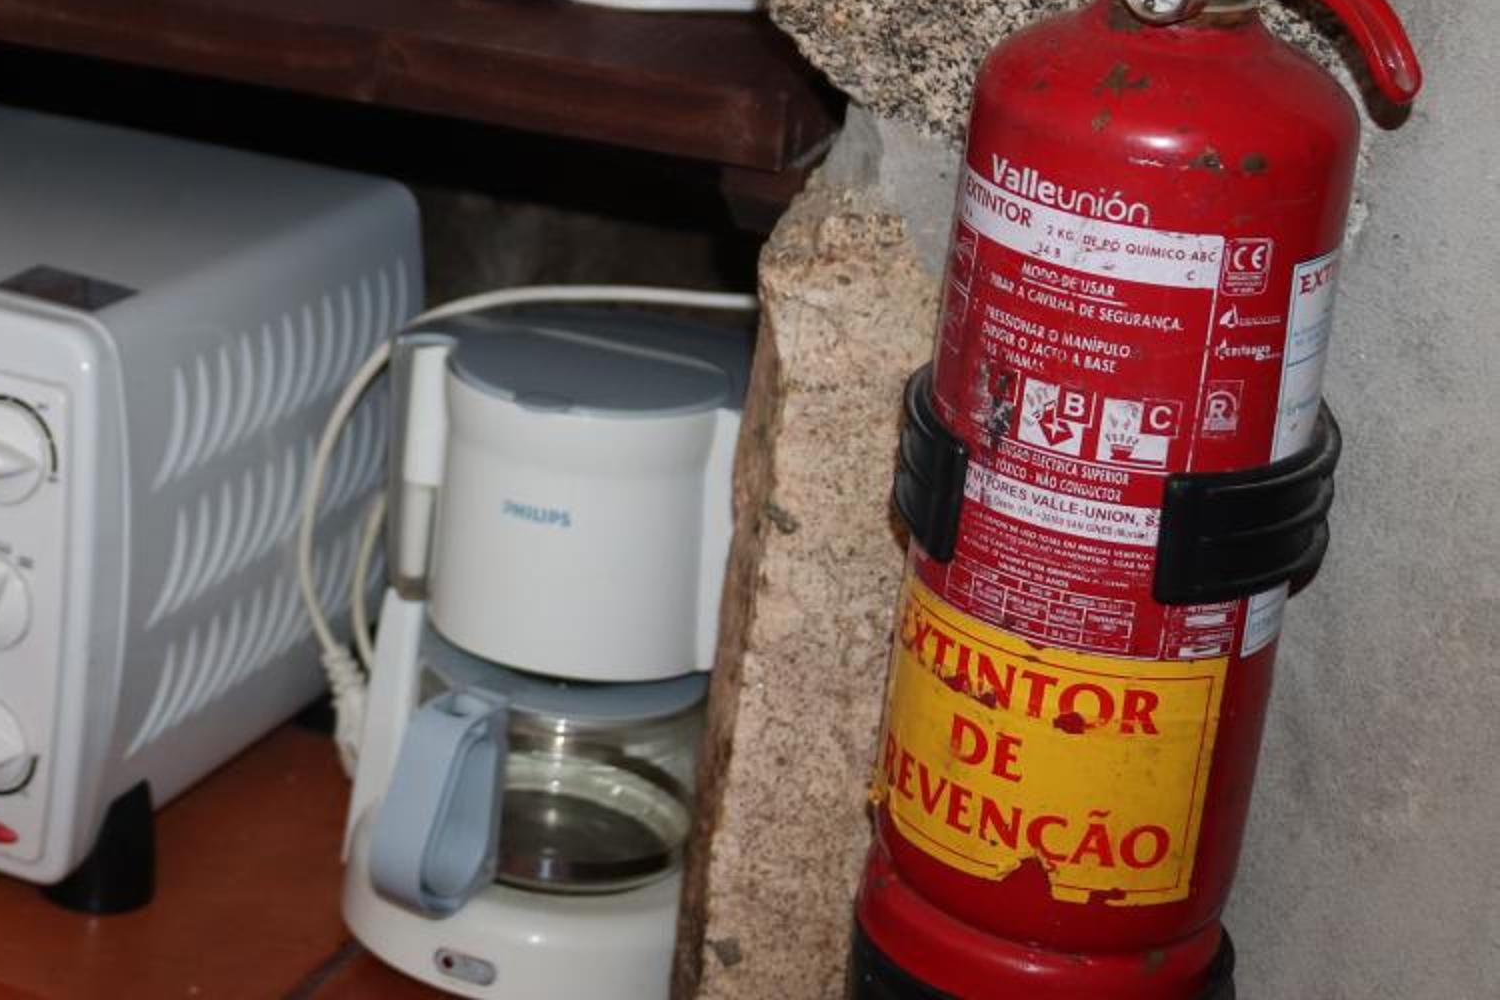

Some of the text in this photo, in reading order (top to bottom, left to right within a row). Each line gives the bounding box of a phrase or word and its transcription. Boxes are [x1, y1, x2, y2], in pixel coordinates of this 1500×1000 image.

[991, 153, 1151, 226] Valleunión
[966, 176, 1033, 229] EXTINTOR
[1081, 234, 1098, 248] DE
[1125, 242, 1186, 262] QUÍMICO
[1190, 249, 1218, 264] ABC
[1021, 262, 1116, 298] MODO DE USAR
[1079, 303, 1095, 319] DE
[1048, 329, 1059, 342] O
[1017, 337, 1028, 351] O
[1084, 355, 1117, 374] BASE
[1063, 391, 1086, 418] B
[1149, 405, 1173, 431] C
[1035, 470, 1058, 490] NÃO
[1059, 478, 1123, 503] CONDUCTOR
[1081, 465, 1131, 487] SUPERIOR
[951, 713, 1023, 783] DE
